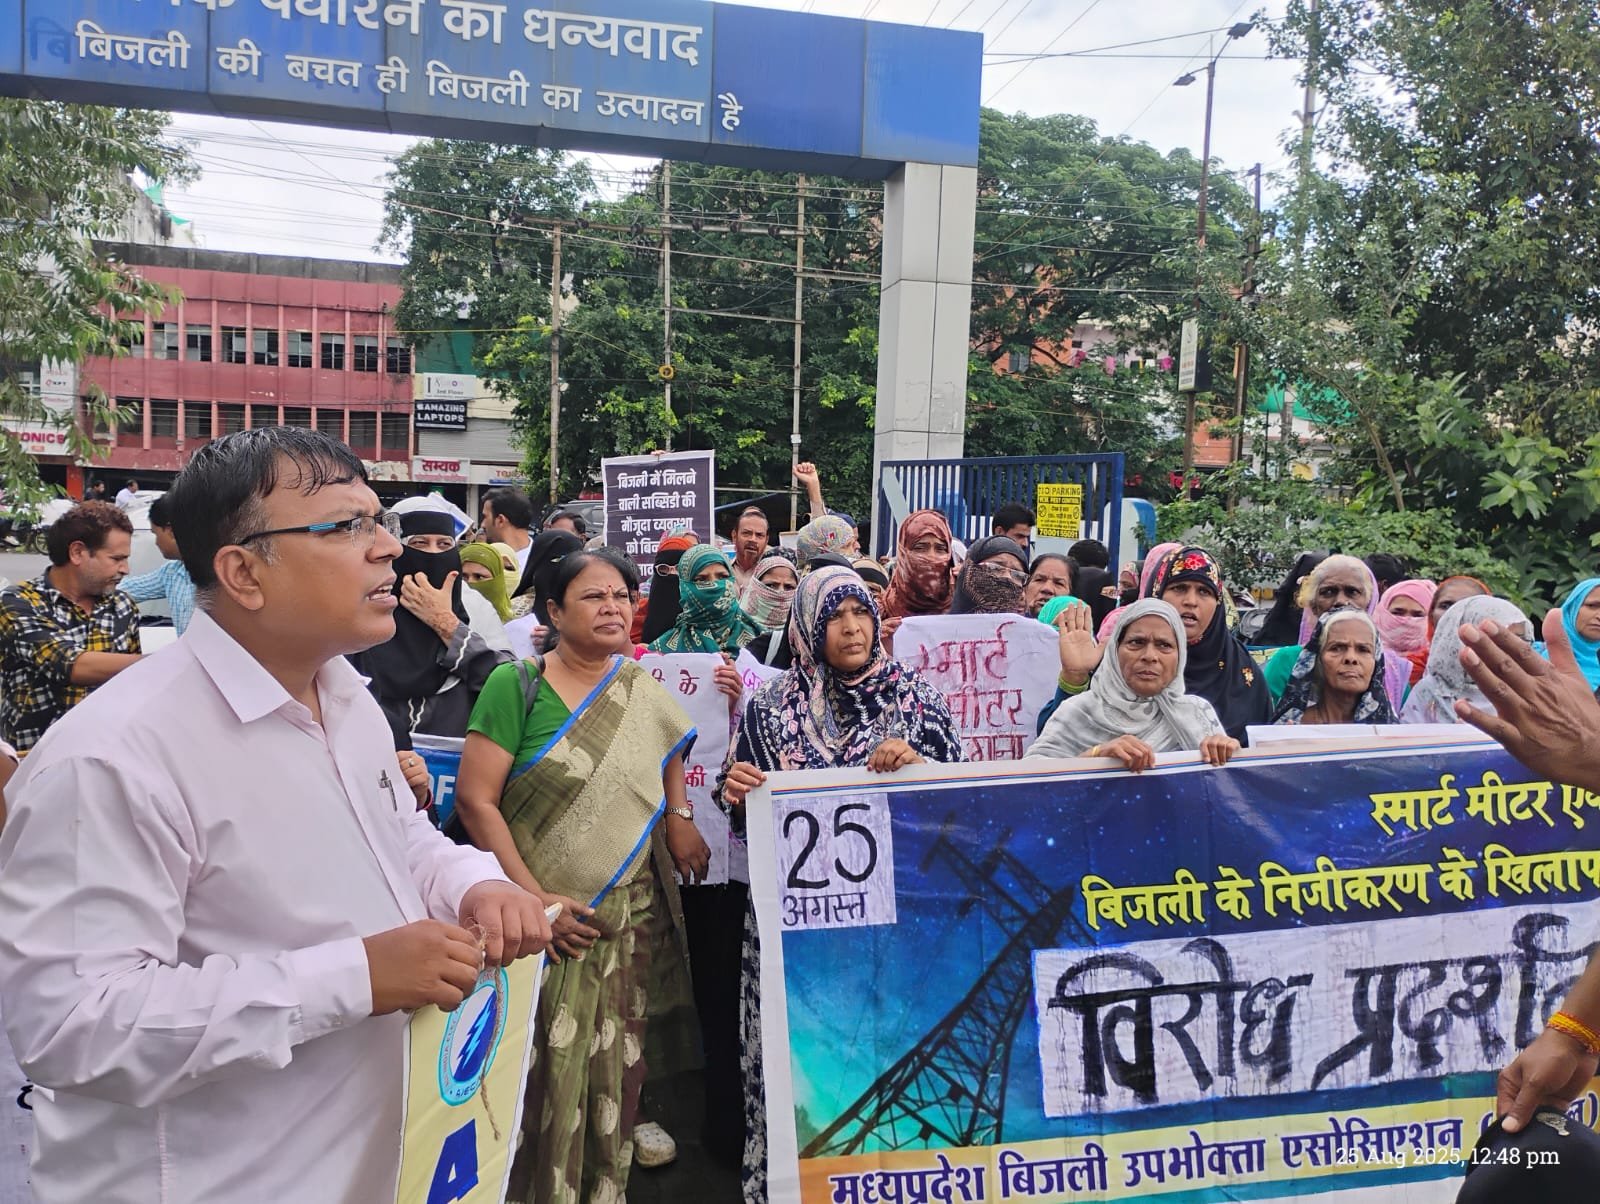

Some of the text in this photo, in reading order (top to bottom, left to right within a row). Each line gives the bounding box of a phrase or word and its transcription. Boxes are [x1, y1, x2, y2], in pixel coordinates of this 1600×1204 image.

[441, 0, 506, 44] का
[523, 8, 703, 66] धन्यवाद
[74, 20, 743, 131] बिजली की बचत ही बिजली का उत्पादन है
[417, 413, 465, 423] LAPTOPS
[425, 403, 465, 412] AMAZING
[422, 459, 460, 473] सम्यक
[617, 468, 697, 489] बिजली में मिलने
[618, 491, 696, 511] वाली सब्सिडी की
[1052, 488, 1080, 496] PARKING
[621, 516, 652, 536] मौजूदा
[626, 539, 638, 555] को
[1370, 774, 1460, 836] स्मार्ट
[1465, 770, 1555, 829] मीटर
[782, 803, 878, 889] 25
[1082, 868, 1209, 930] बिजली
[1214, 866, 1256, 919] के
[1259, 856, 1435, 913] निजीकरण
[1437, 847, 1479, 900] के
[782, 891, 868, 927] अगस्त
[1048, 937, 1315, 1103] विरोध
[830, 1117, 1464, 1204] मध्यप्रदेश बिजली उपभोक्ता एसोसिएशन
